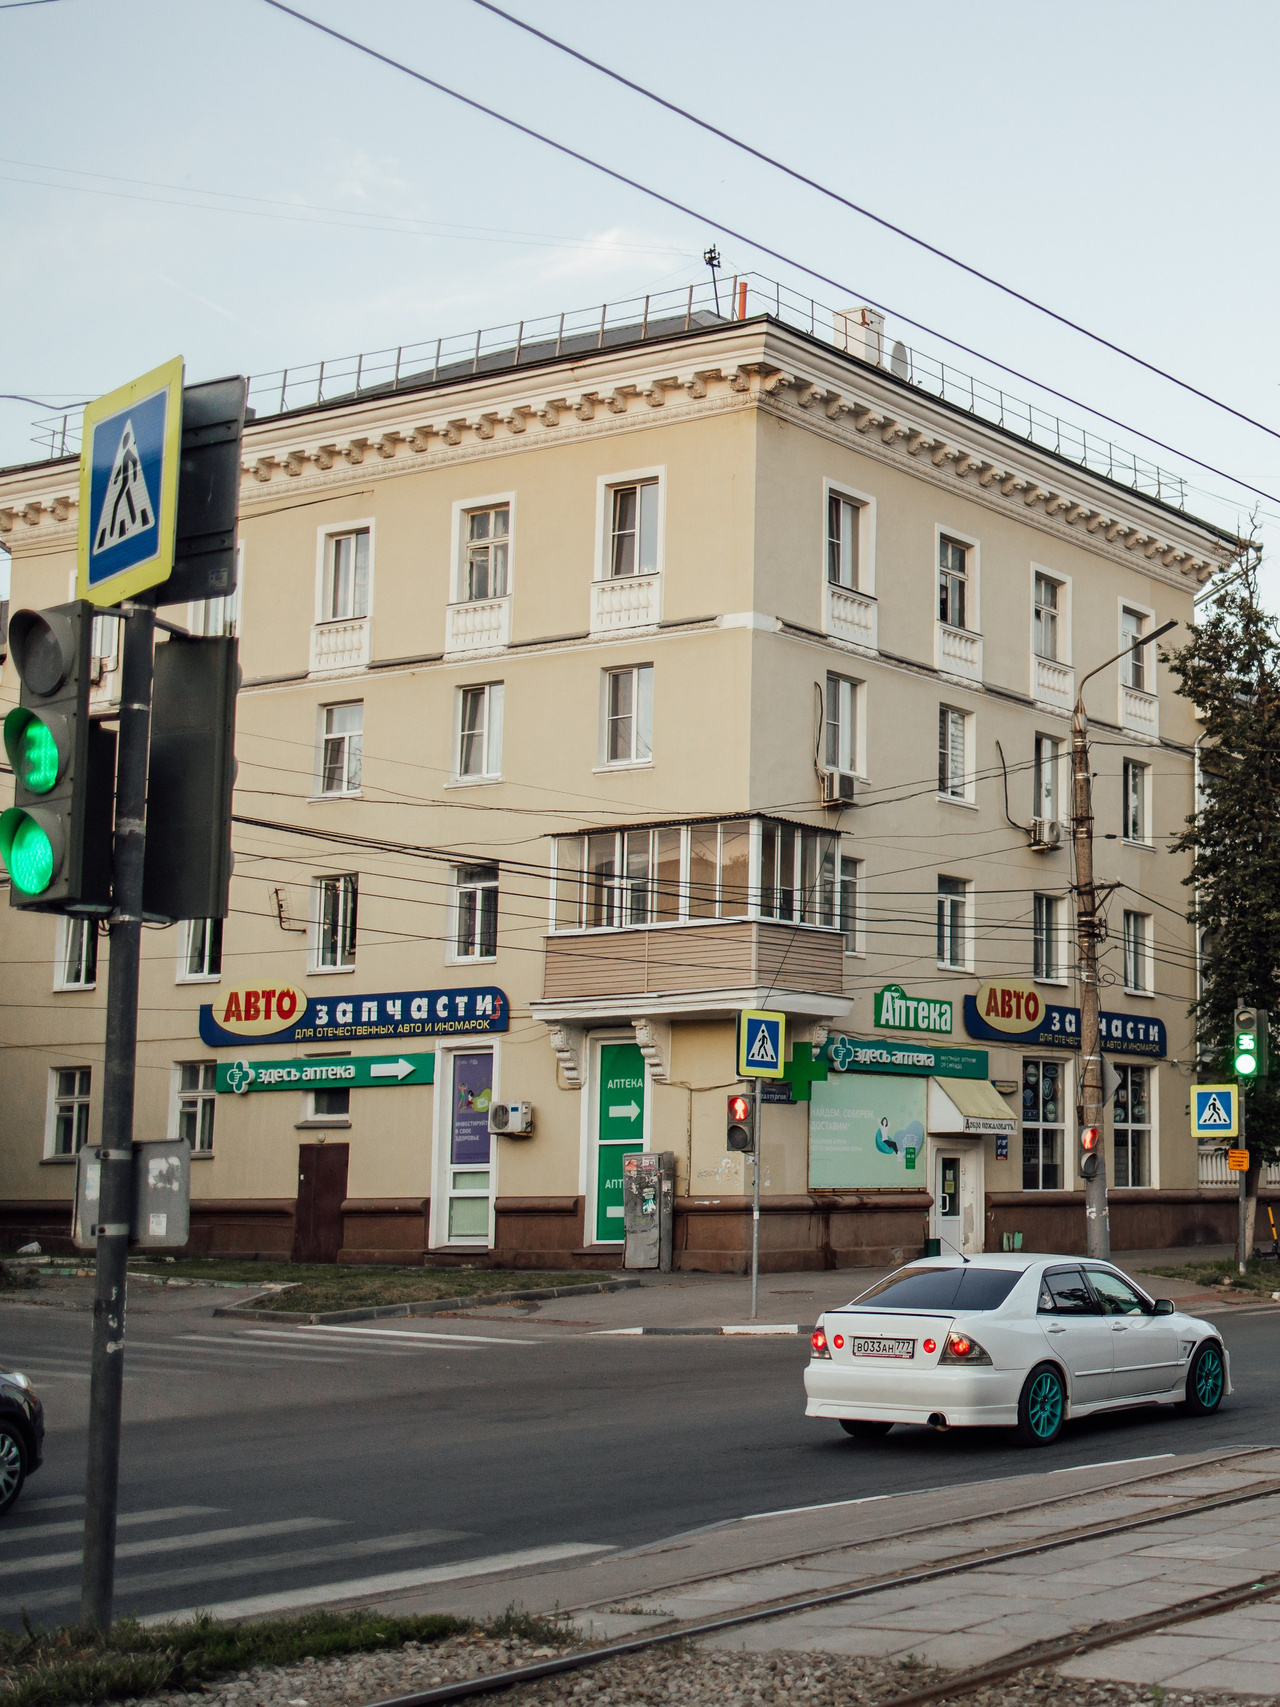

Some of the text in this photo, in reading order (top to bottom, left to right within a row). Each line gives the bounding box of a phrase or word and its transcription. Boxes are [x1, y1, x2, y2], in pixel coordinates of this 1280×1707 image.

[223, 988, 297, 1023] АВТО
[880, 991, 951, 1031] Аптека
[985, 987, 1159, 1042] АВТО зачасти
[294, 1019, 491, 1040] ДЛЯ ОТЕЧЕСТВЕННЫХ АВТО И ИНОМАРОК
[1039, 1033, 1054, 1043] ДЛЯ
[1106, 1041, 1122, 1050] АВТО
[1122, 1042, 1128, 1050] И
[1128, 1044, 1160, 1053] ИНОМАРОК
[853, 1047, 935, 1067] здесь аптека
[257, 1063, 356, 1084] здесь аптека
[607, 1078, 643, 1089] АПТЕКА
[455, 1119, 489, 1128] ИНВЕСТИРУЙТ
[965, 1118, 981, 1132] Добро
[605, 1179, 624, 1189] АПТ
[896, 1340, 911, 1351] 777
